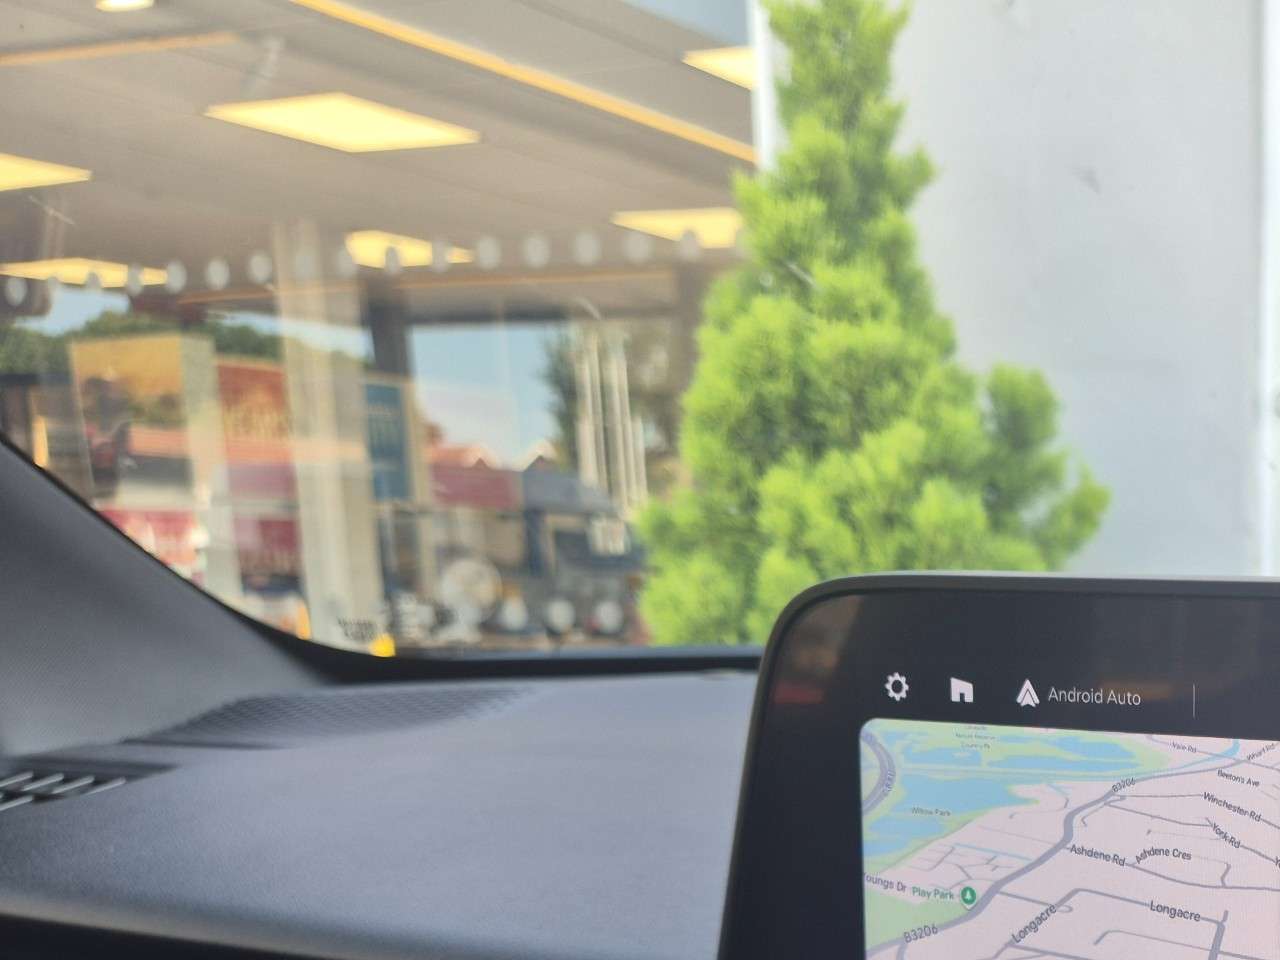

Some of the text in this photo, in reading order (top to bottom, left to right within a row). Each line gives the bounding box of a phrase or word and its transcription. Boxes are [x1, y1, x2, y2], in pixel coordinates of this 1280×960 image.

[1048, 687, 1141, 706] Android Auto
[1112, 777, 1136, 793] B3206
[1245, 777, 1260, 787] Ave
[1203, 791, 1262, 822] Winchester Rd
[1212, 822, 1241, 849] York Rd
[1070, 844, 1126, 867] Ashdene Rd
[1135, 848, 1192, 865] Ashdene Cres
[896, 881, 907, 892] Dr
[911, 886, 954, 901] Play Park
[1150, 899, 1202, 922] Longacre
[1011, 904, 1058, 944] Longacre
[903, 924, 939, 944] B3206
